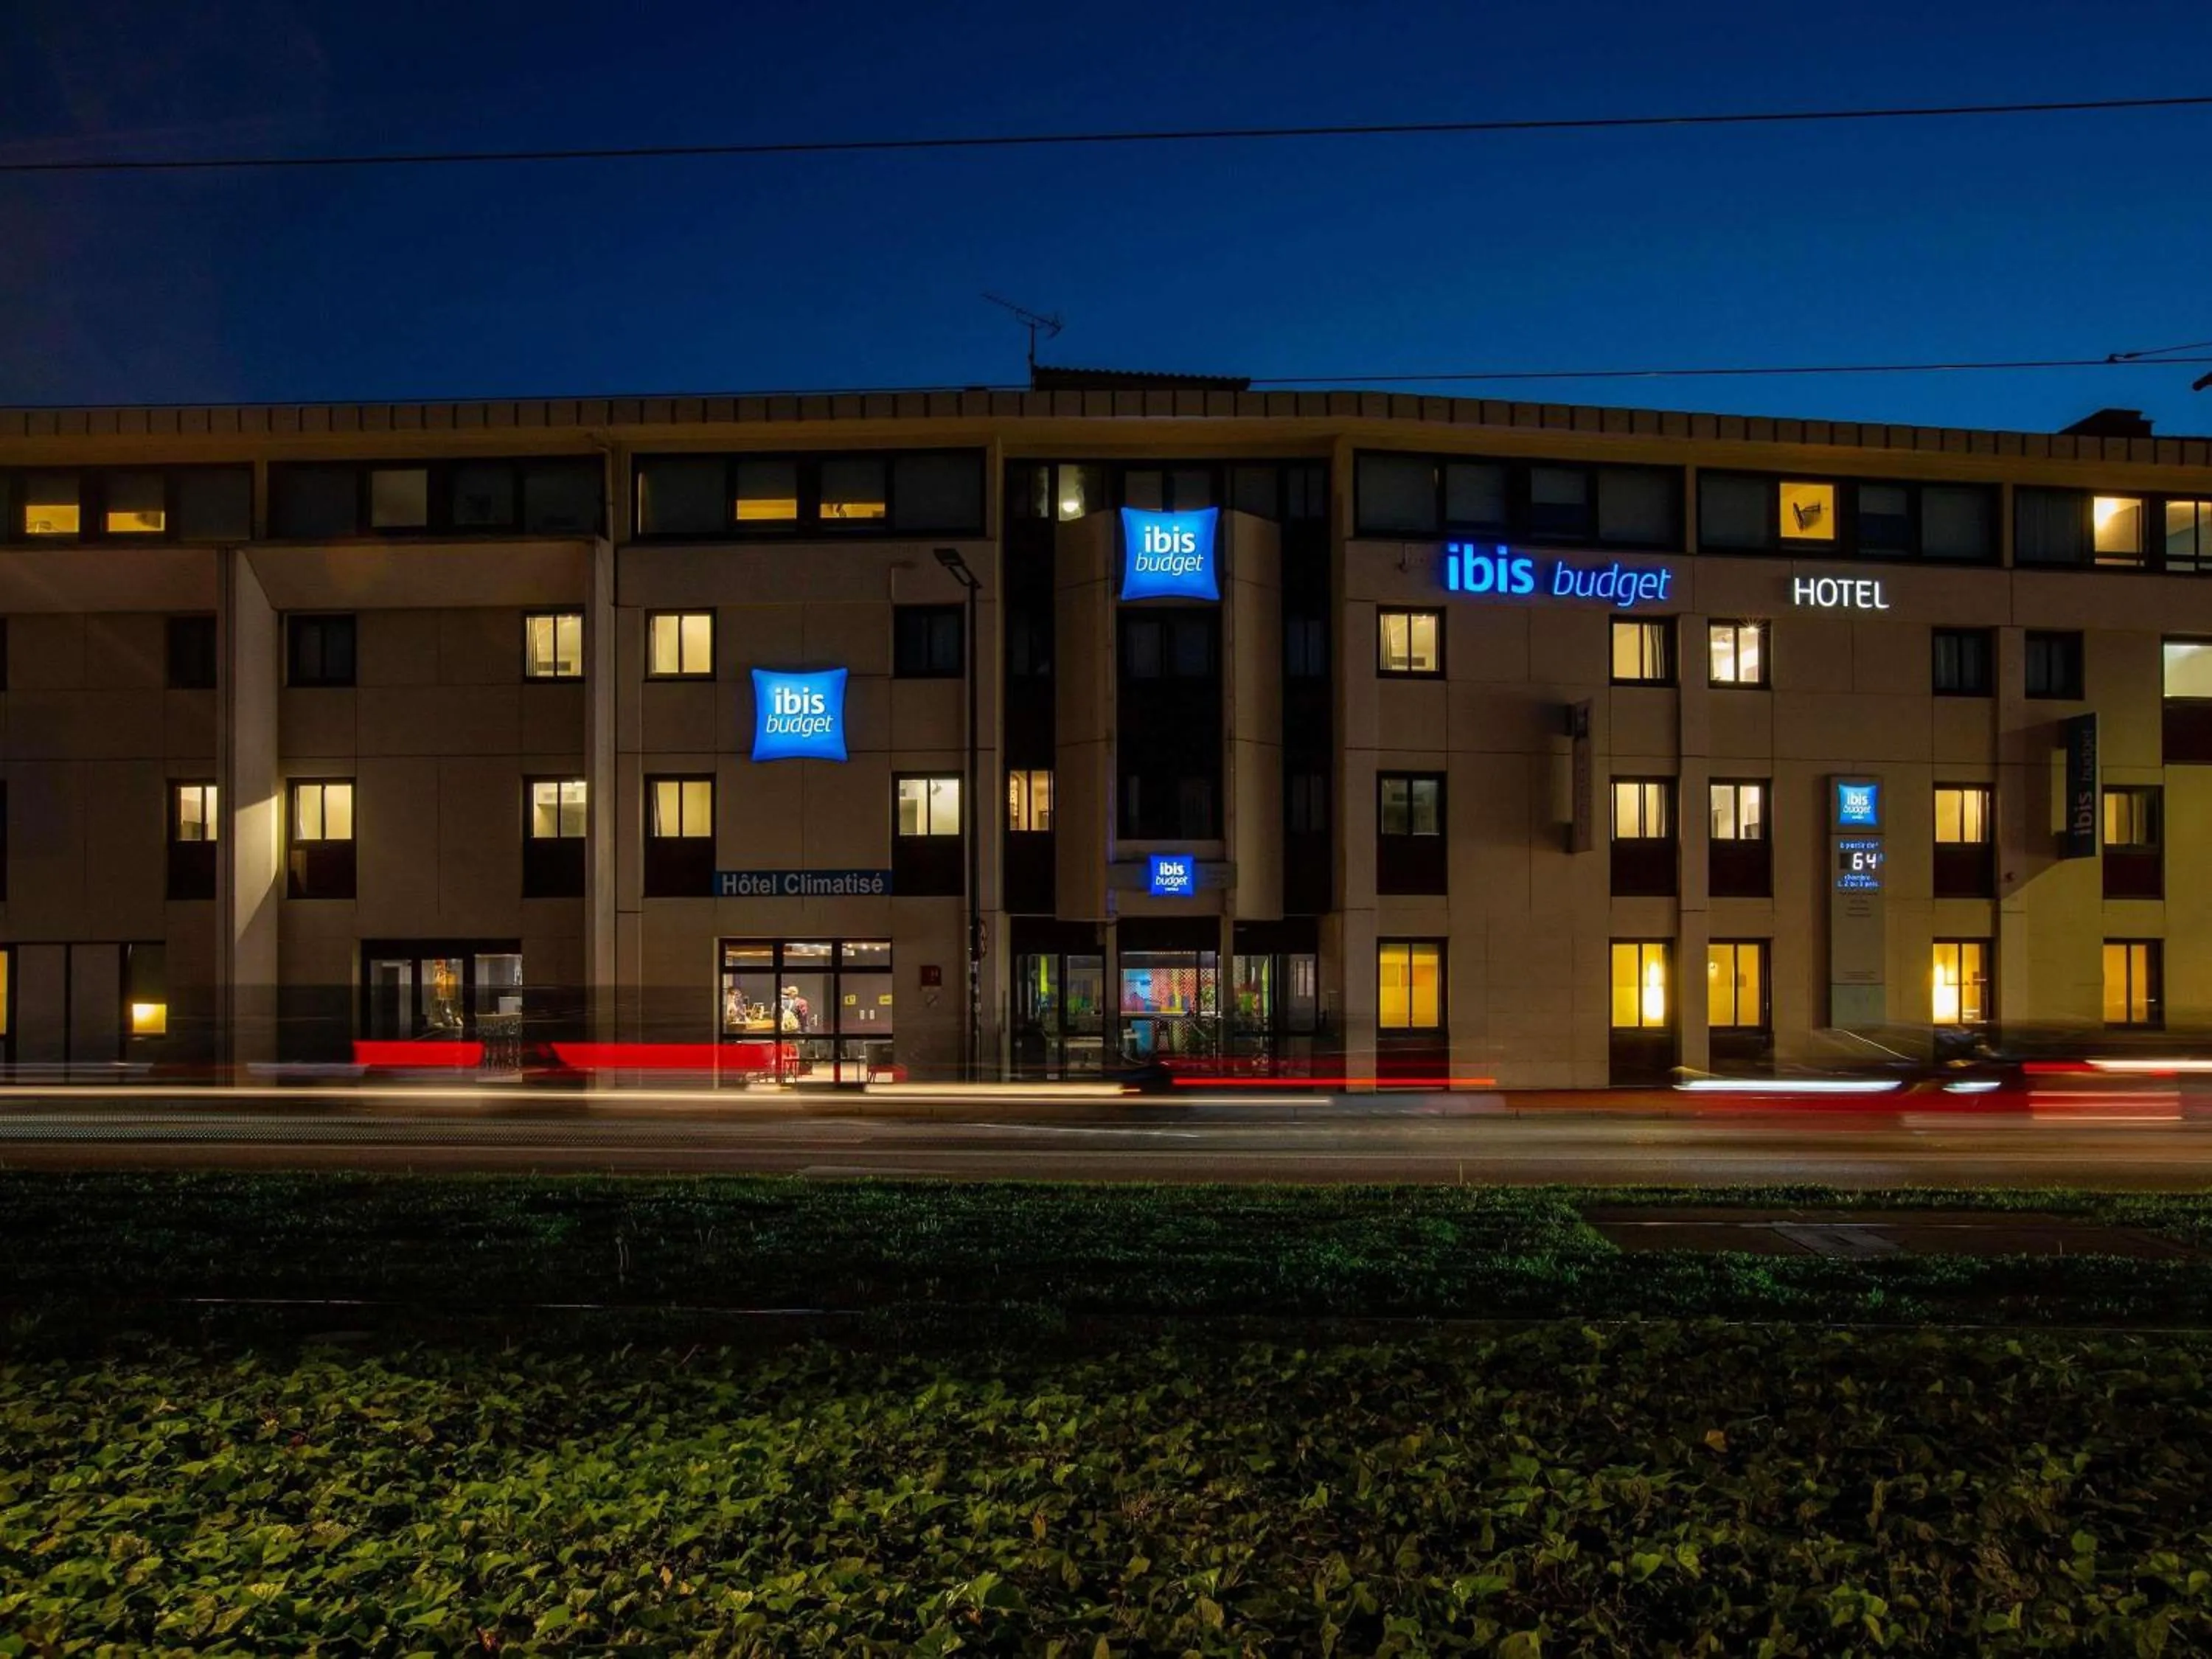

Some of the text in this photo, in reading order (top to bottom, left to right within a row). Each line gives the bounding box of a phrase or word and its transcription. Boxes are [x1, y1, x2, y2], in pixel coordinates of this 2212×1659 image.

[1144, 526, 1196, 554] ibis
[1135, 553, 1204, 577] budget
[1448, 543, 1672, 607] ibis budget
[1793, 577, 1890, 609] HOTEL
[773, 686, 826, 715] ibis
[766, 714, 834, 737] budget
[1847, 792, 1868, 805] ibis
[1160, 862, 1185, 876] ibis
[1851, 852, 1877, 871] 64
[722, 872, 884, 895] Hôtel Climatisé
[1155, 875, 1188, 887] budget
